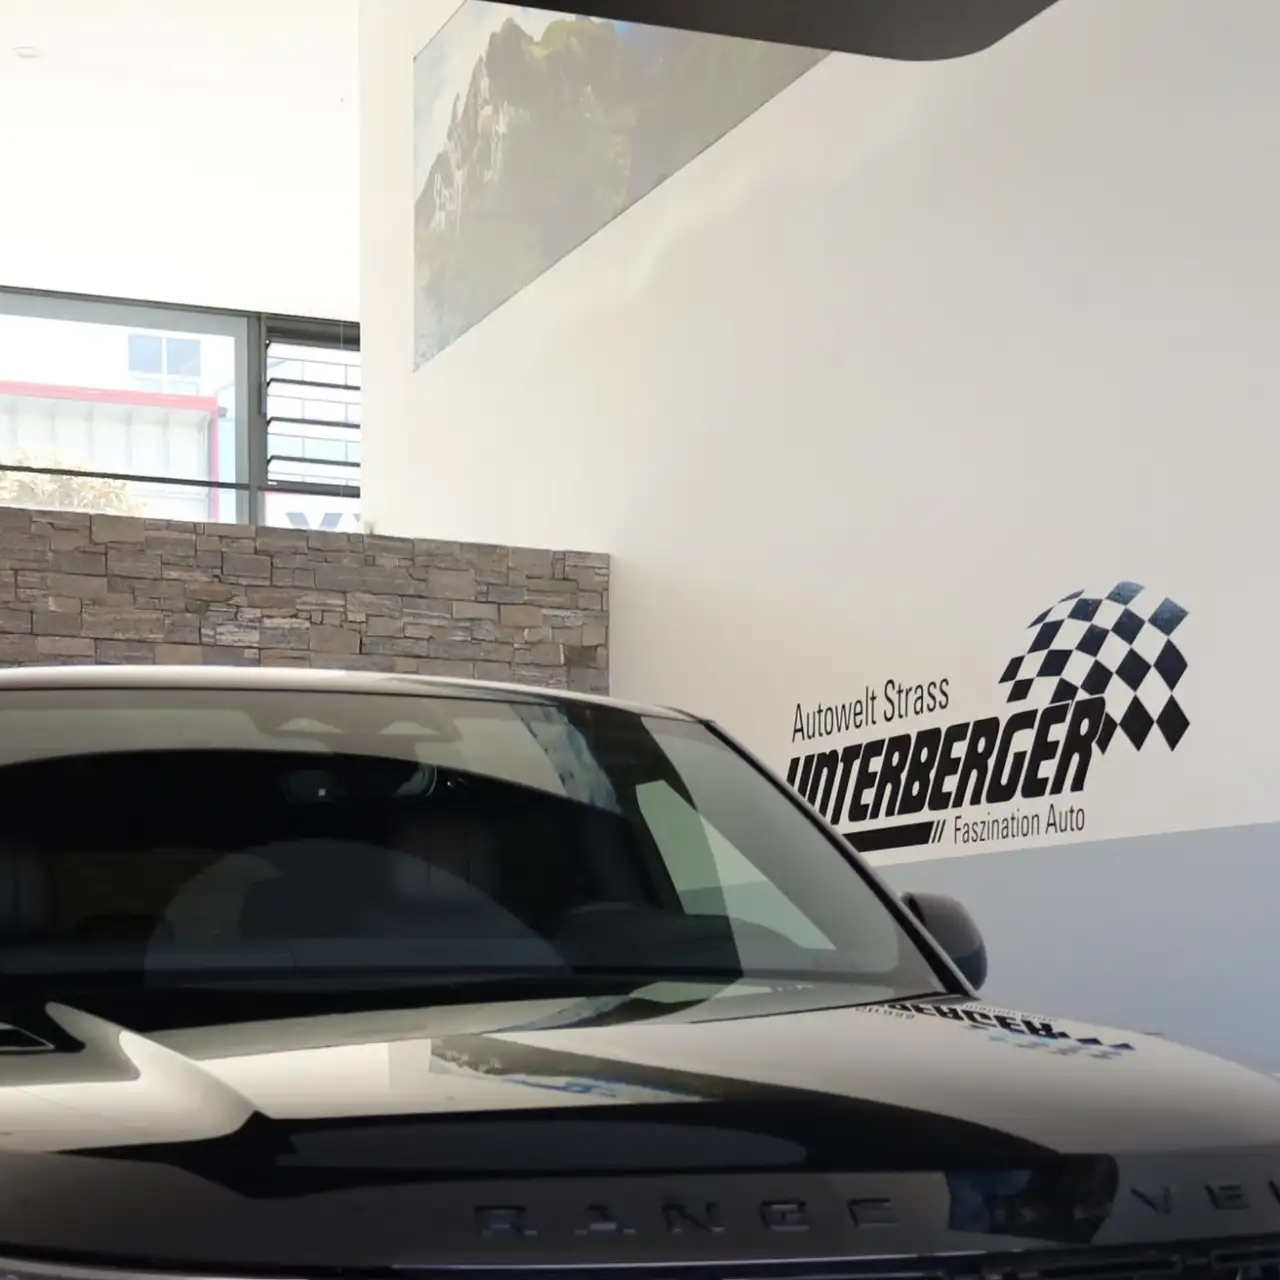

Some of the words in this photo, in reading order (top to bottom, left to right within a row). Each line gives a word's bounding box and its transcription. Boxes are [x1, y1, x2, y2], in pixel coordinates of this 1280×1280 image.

[792, 685, 877, 743] Autowelt
[883, 677, 950, 722] Strass
[954, 808, 1041, 845] Faszination
[1045, 804, 1086, 835] Auto
